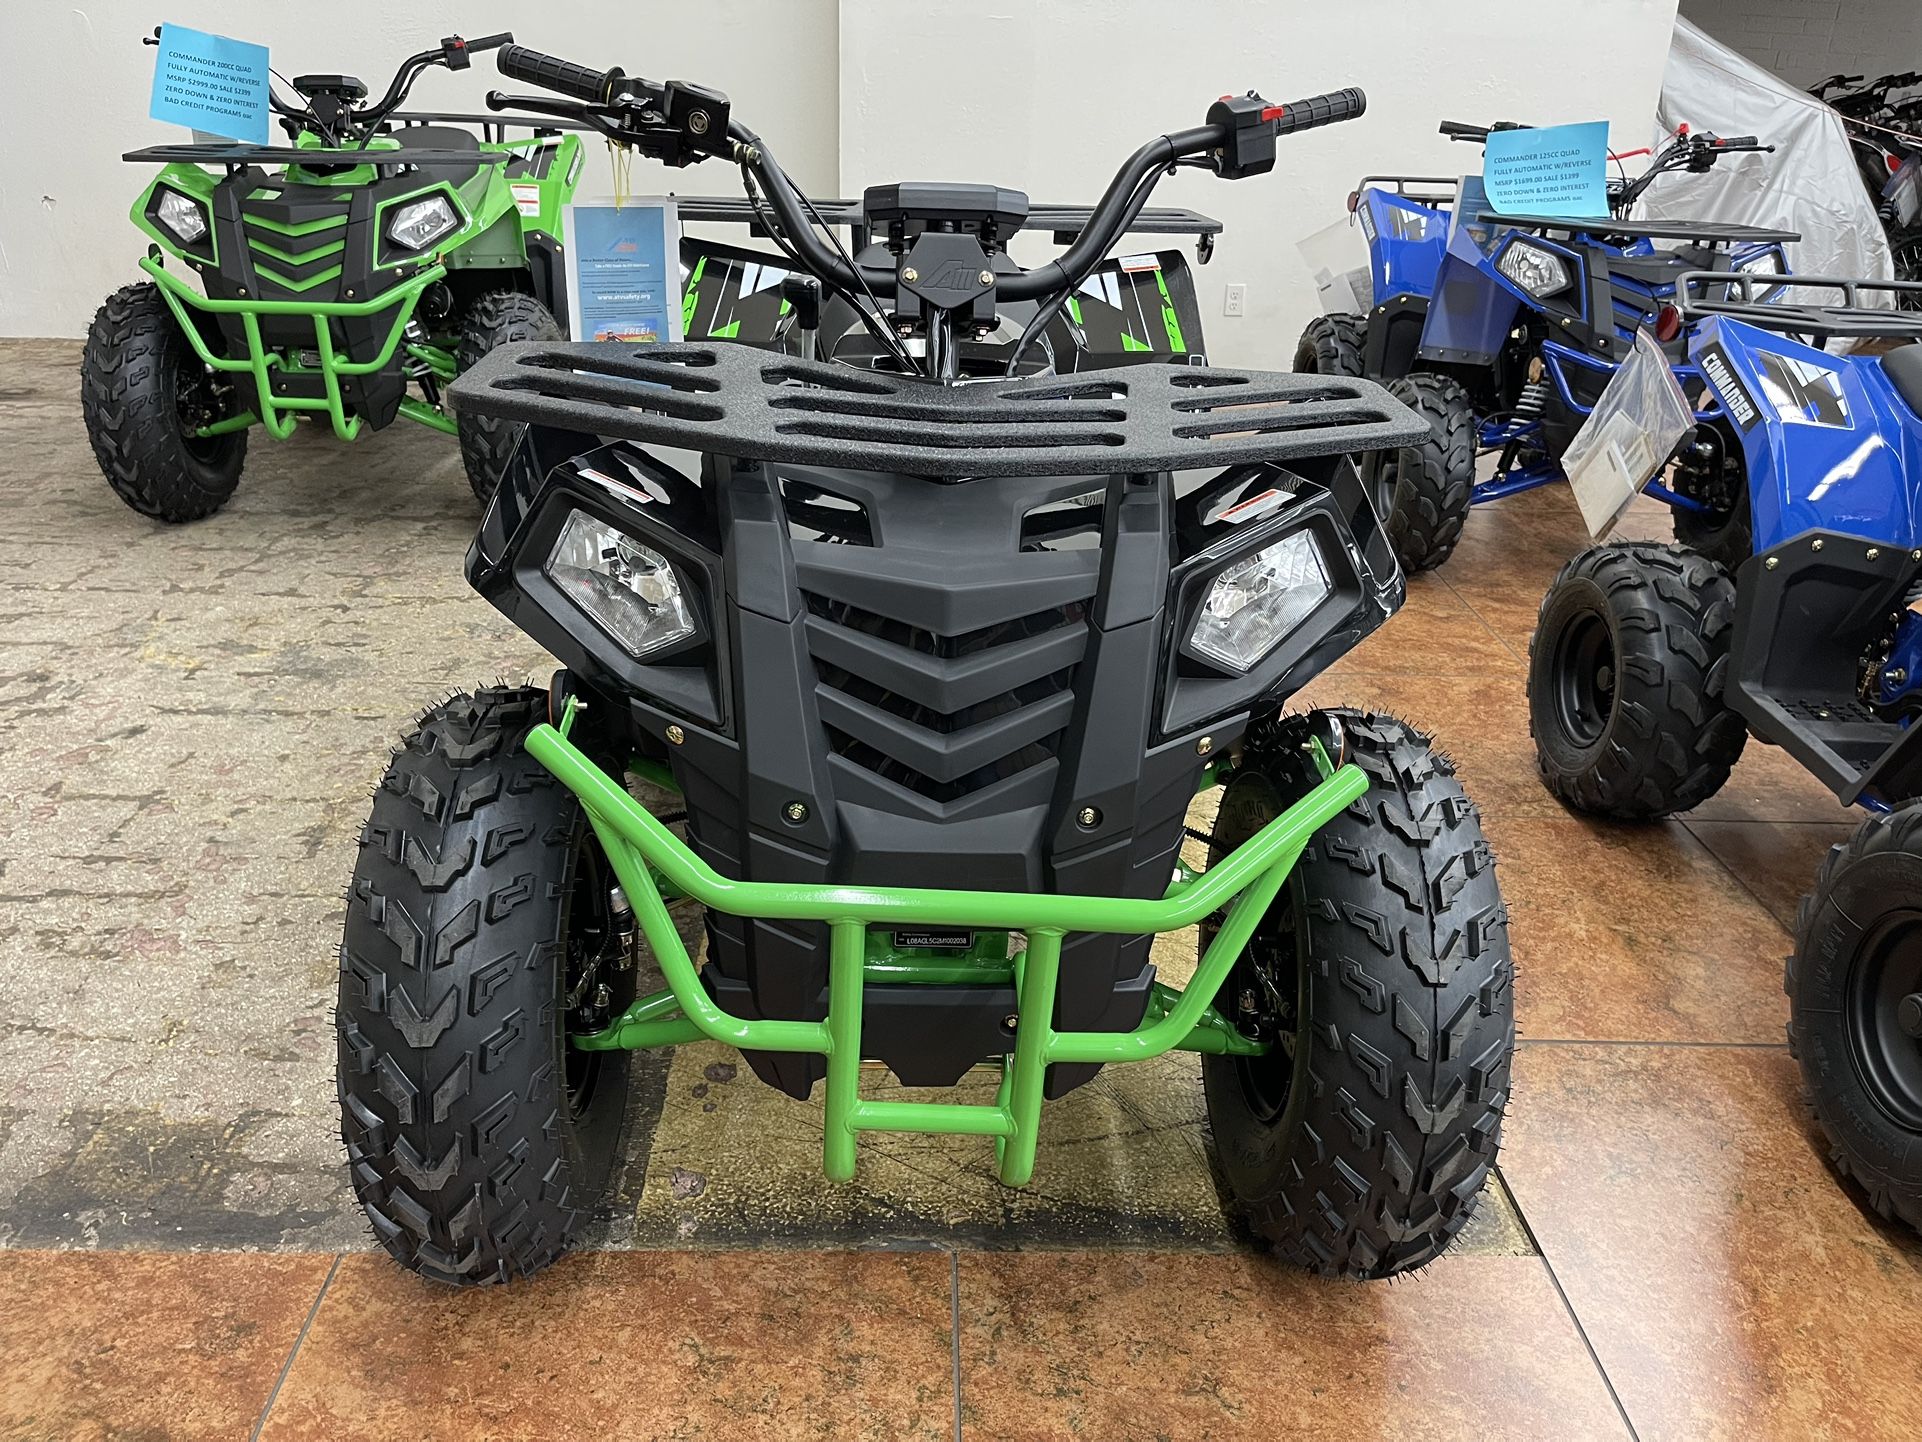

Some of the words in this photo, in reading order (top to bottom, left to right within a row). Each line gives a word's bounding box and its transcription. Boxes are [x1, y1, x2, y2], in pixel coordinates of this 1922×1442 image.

[168, 50, 216, 67] COMMANDER
[217, 61, 235, 71] 200CC
[236, 65, 252, 73] QUAD
[167, 62, 188, 72] FULLY
[188, 65, 229, 81] AUTOMATIC
[230, 76, 261, 86] W/REVERSE
[166, 74, 187, 83] MSRP
[188, 78, 218, 90] $2999.00
[219, 86, 233, 94] SALE
[234, 88, 251, 97] $2399
[164, 96, 180, 105] BAD
[180, 99, 205, 110] CREDIT
[206, 105, 242, 117] PROGRAMS
[165, 84, 184, 94] ZERO
[185, 90, 208, 100] DOWN
[216, 96, 232, 104] ZERO
[233, 99, 259, 109] INTEREST
[1494, 154, 1538, 164] COMMANDER
[1540, 151, 1559, 160] 125CC
[1560, 149, 1580, 158] QUAD
[1494, 168, 1512, 176] FULLY
[1514, 163, 1553, 174] AUTOMATIC
[1554, 160, 1592, 170] W/REVERSE
[1494, 179, 1513, 187] MSRP
[1544, 174, 1558, 182] SALE
[1514, 188, 1535, 196] DOWN
[1560, 182, 1590, 192] INTEREST
[624, 326, 650, 335] FREE!
[1702, 352, 1755, 426] COMMANDER
